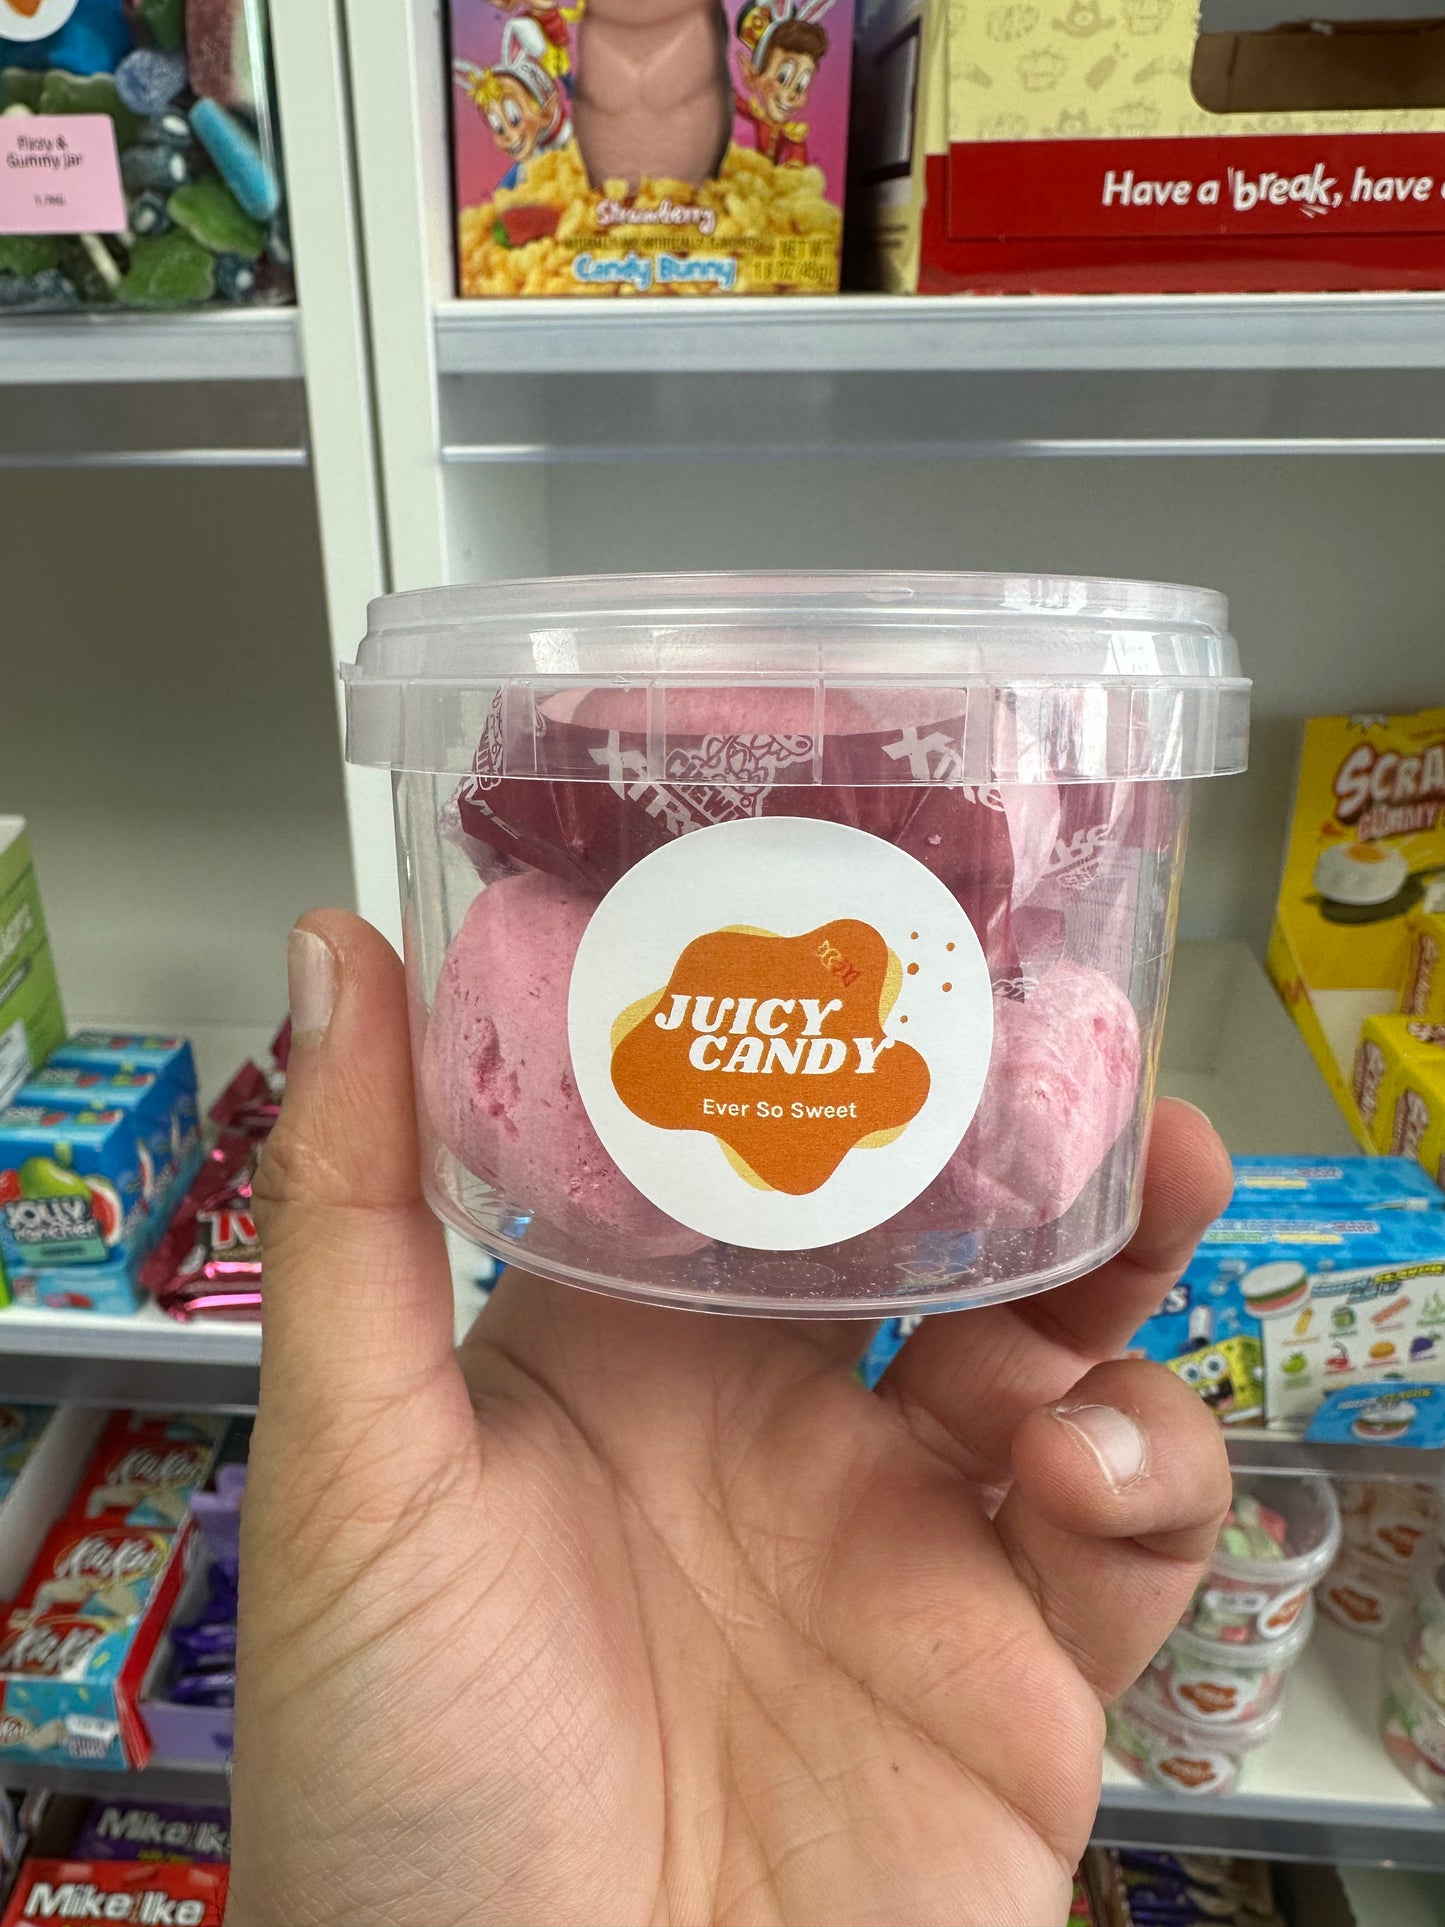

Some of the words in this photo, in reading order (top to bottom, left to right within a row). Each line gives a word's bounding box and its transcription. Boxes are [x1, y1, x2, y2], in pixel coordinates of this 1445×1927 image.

[1102, 169, 1192, 206] Have
[1197, 179, 1220, 202] a
[1228, 163, 1343, 212] break,
[1351, 166, 1433, 201] have
[597, 200, 716, 234] Strawberry
[573, 252, 652, 291] Candy
[655, 253, 738, 291] Bunny
[654, 994, 843, 1036] JUICY
[688, 1034, 895, 1075] CANDY
[703, 1098, 750, 1117] Ever
[756, 1101, 783, 1119] So
[791, 1102, 857, 1119] Sweet
[24, 1882, 133, 1920] Mike
